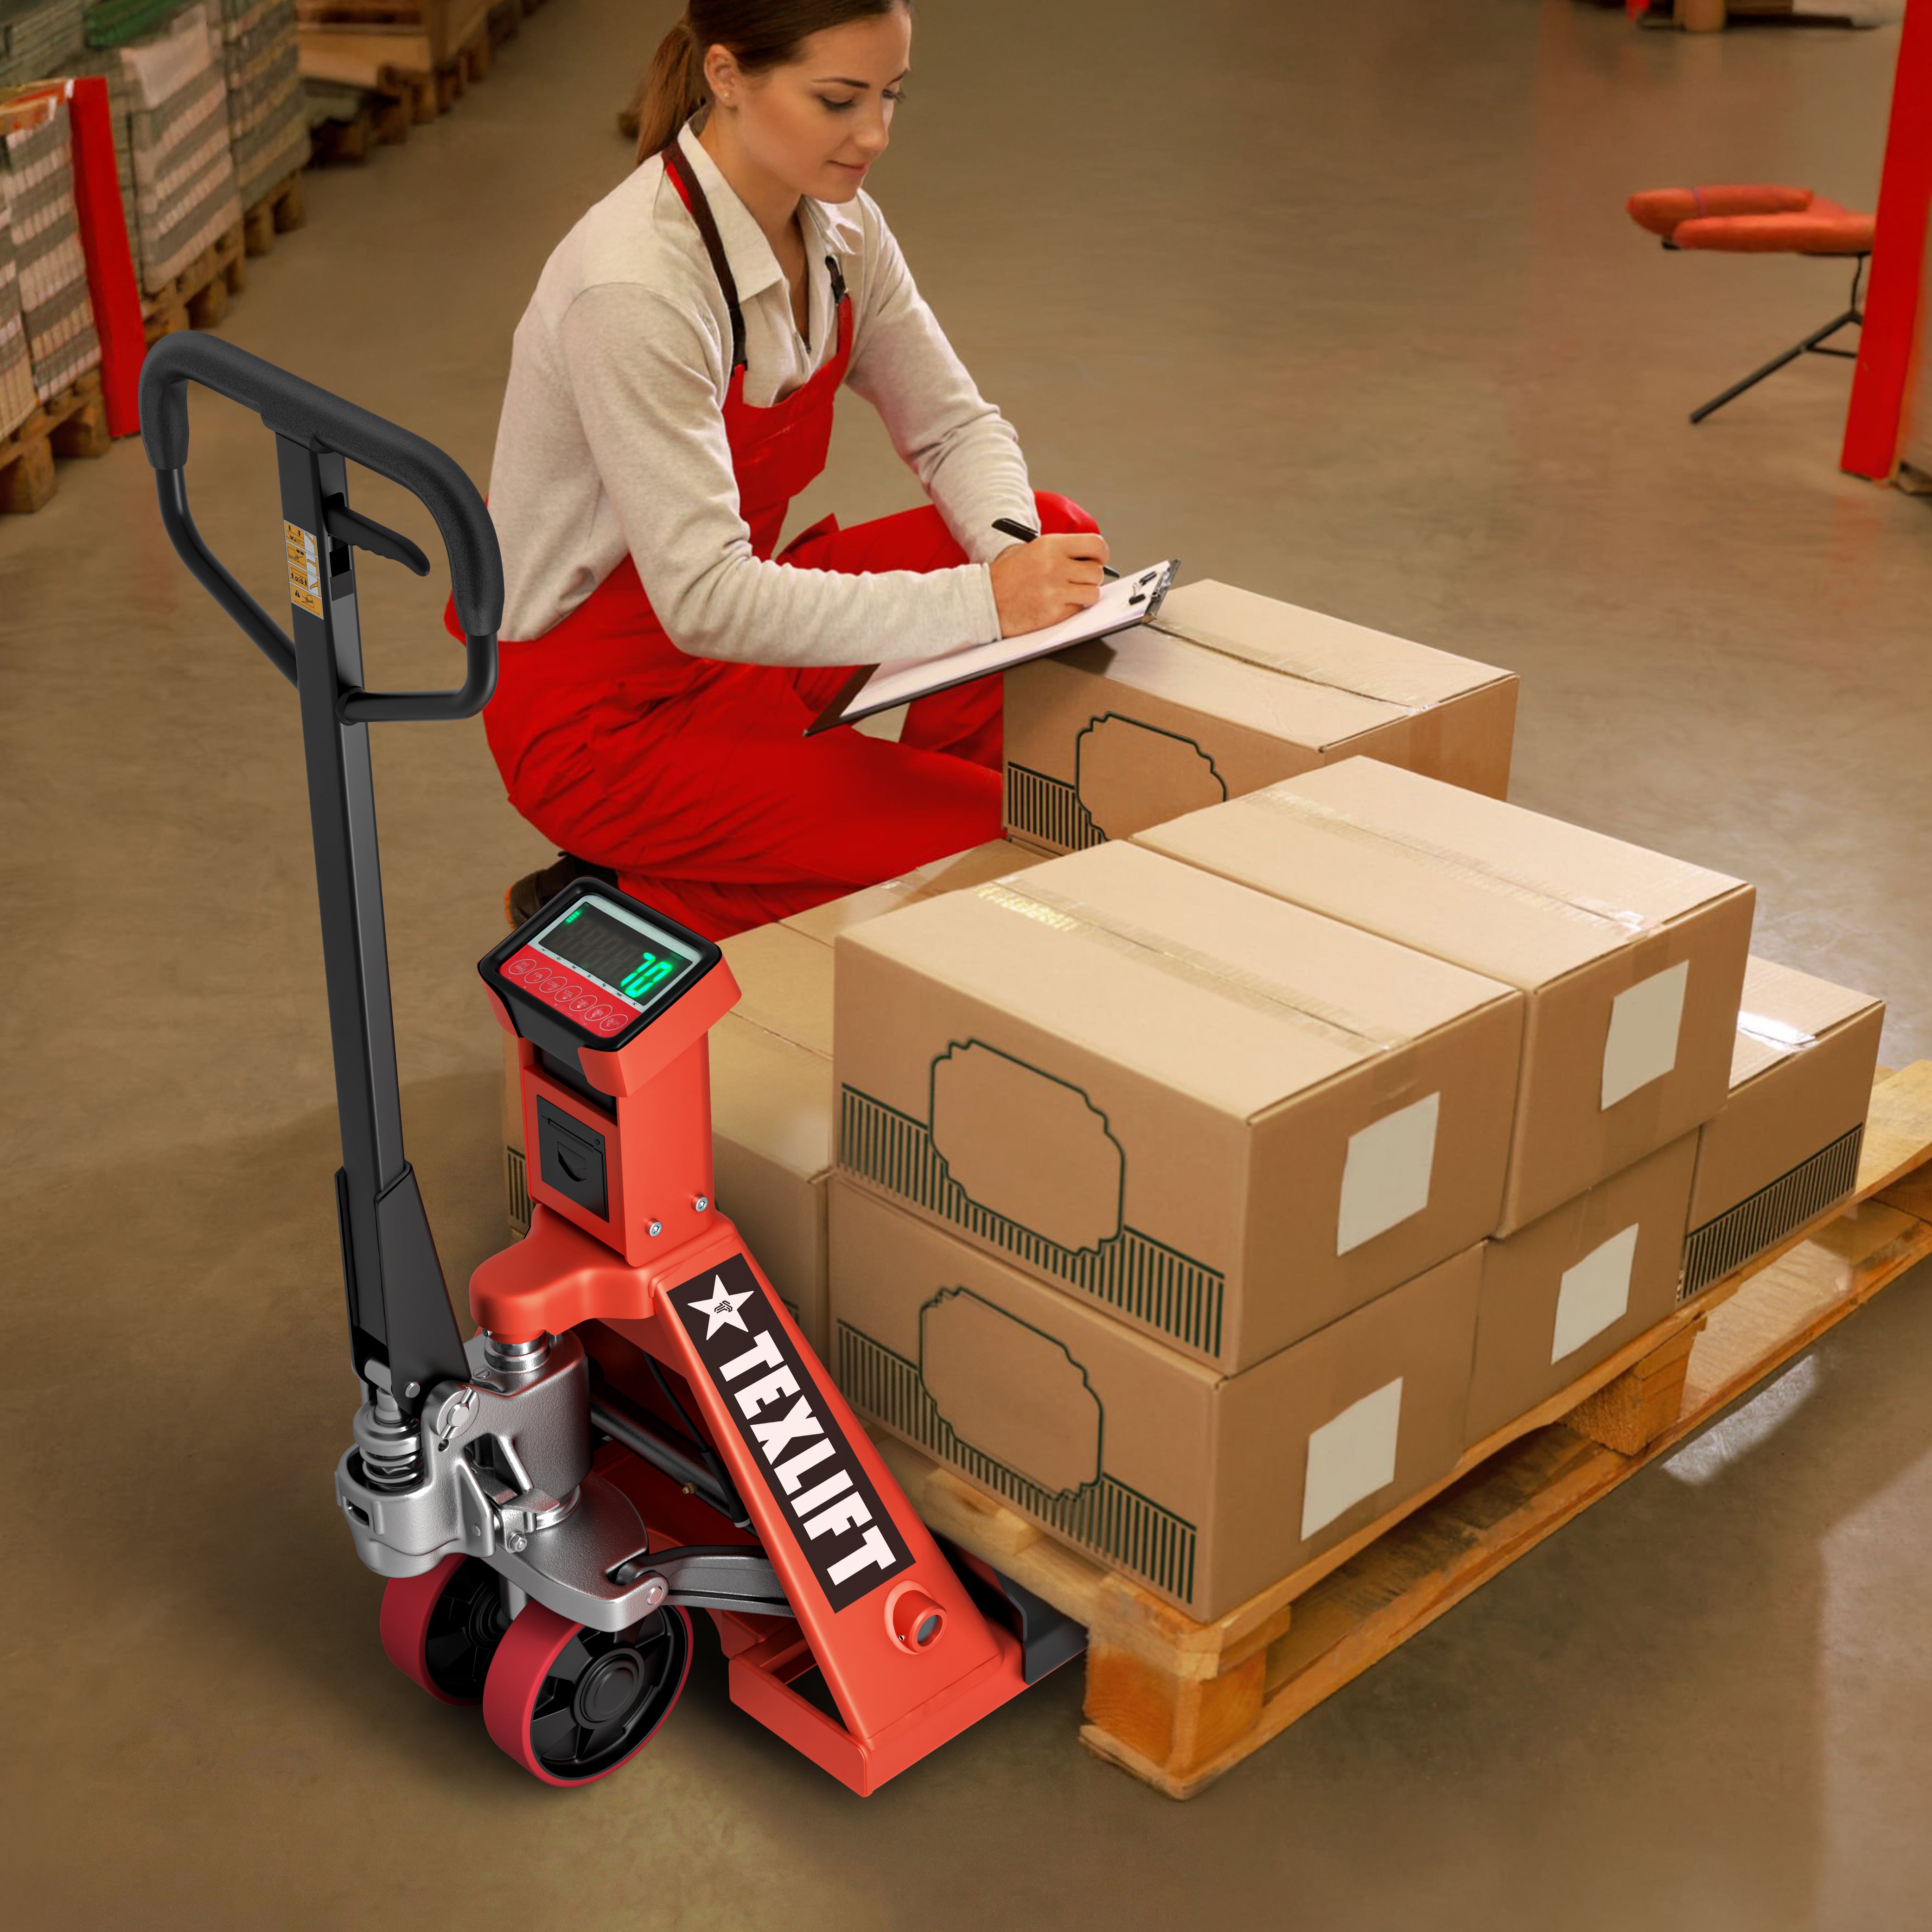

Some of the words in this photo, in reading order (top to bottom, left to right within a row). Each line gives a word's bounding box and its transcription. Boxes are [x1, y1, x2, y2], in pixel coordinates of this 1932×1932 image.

[620, 952, 672, 998] 70
[547, 980, 560, 988] COUNT
[563, 989, 574, 998] TOTAL
[594, 1008, 604, 1017] TARE
[719, 1330, 896, 1586] TEXLIFT
